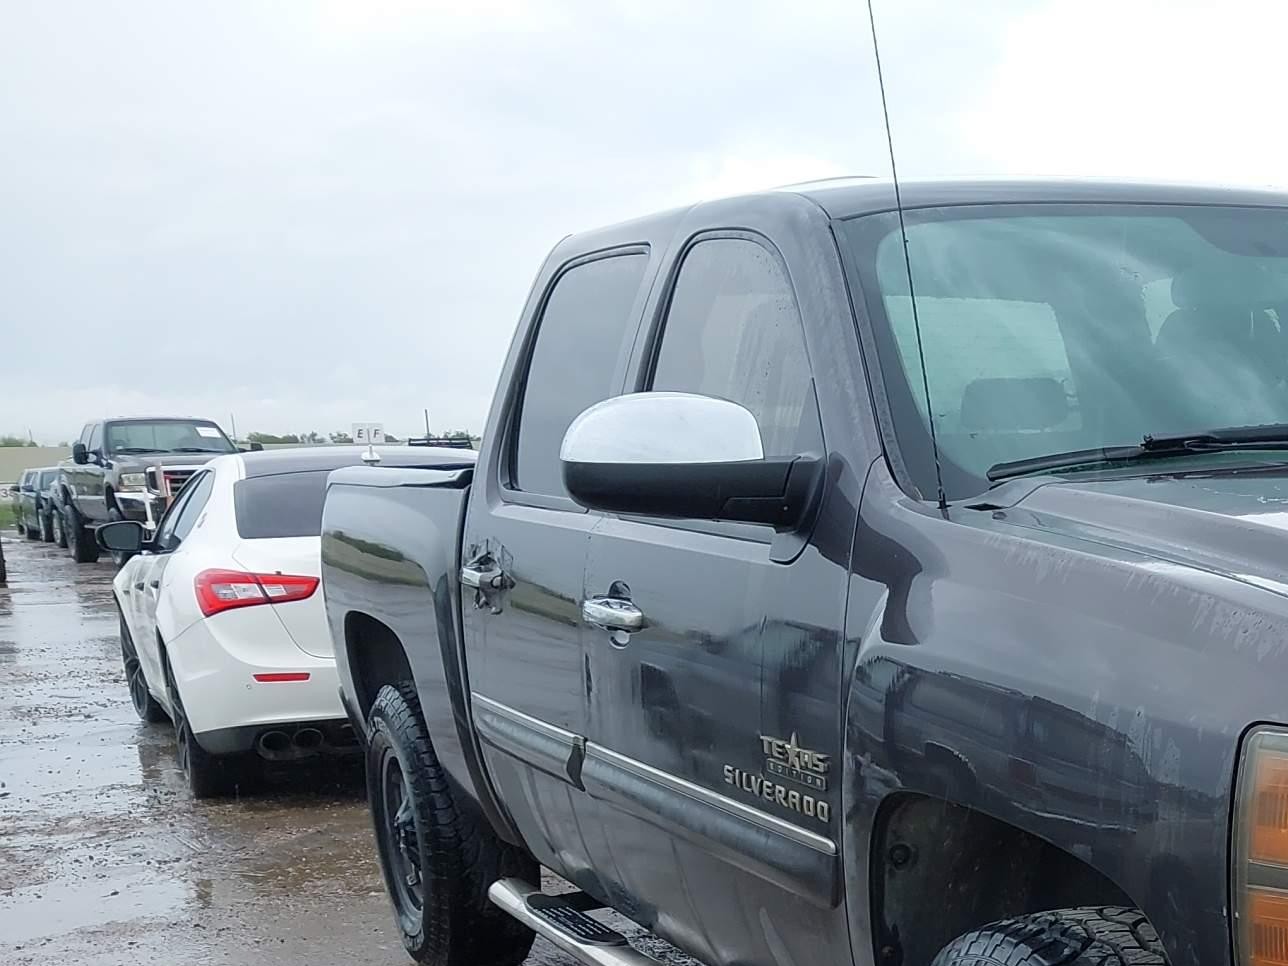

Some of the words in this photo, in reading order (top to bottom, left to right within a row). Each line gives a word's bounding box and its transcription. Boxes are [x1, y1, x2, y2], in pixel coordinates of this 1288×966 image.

[357, 428, 364, 438] E
[373, 428, 380, 439] F
[760, 733, 831, 773] TEXAS
[723, 764, 829, 823] SILVERADO
